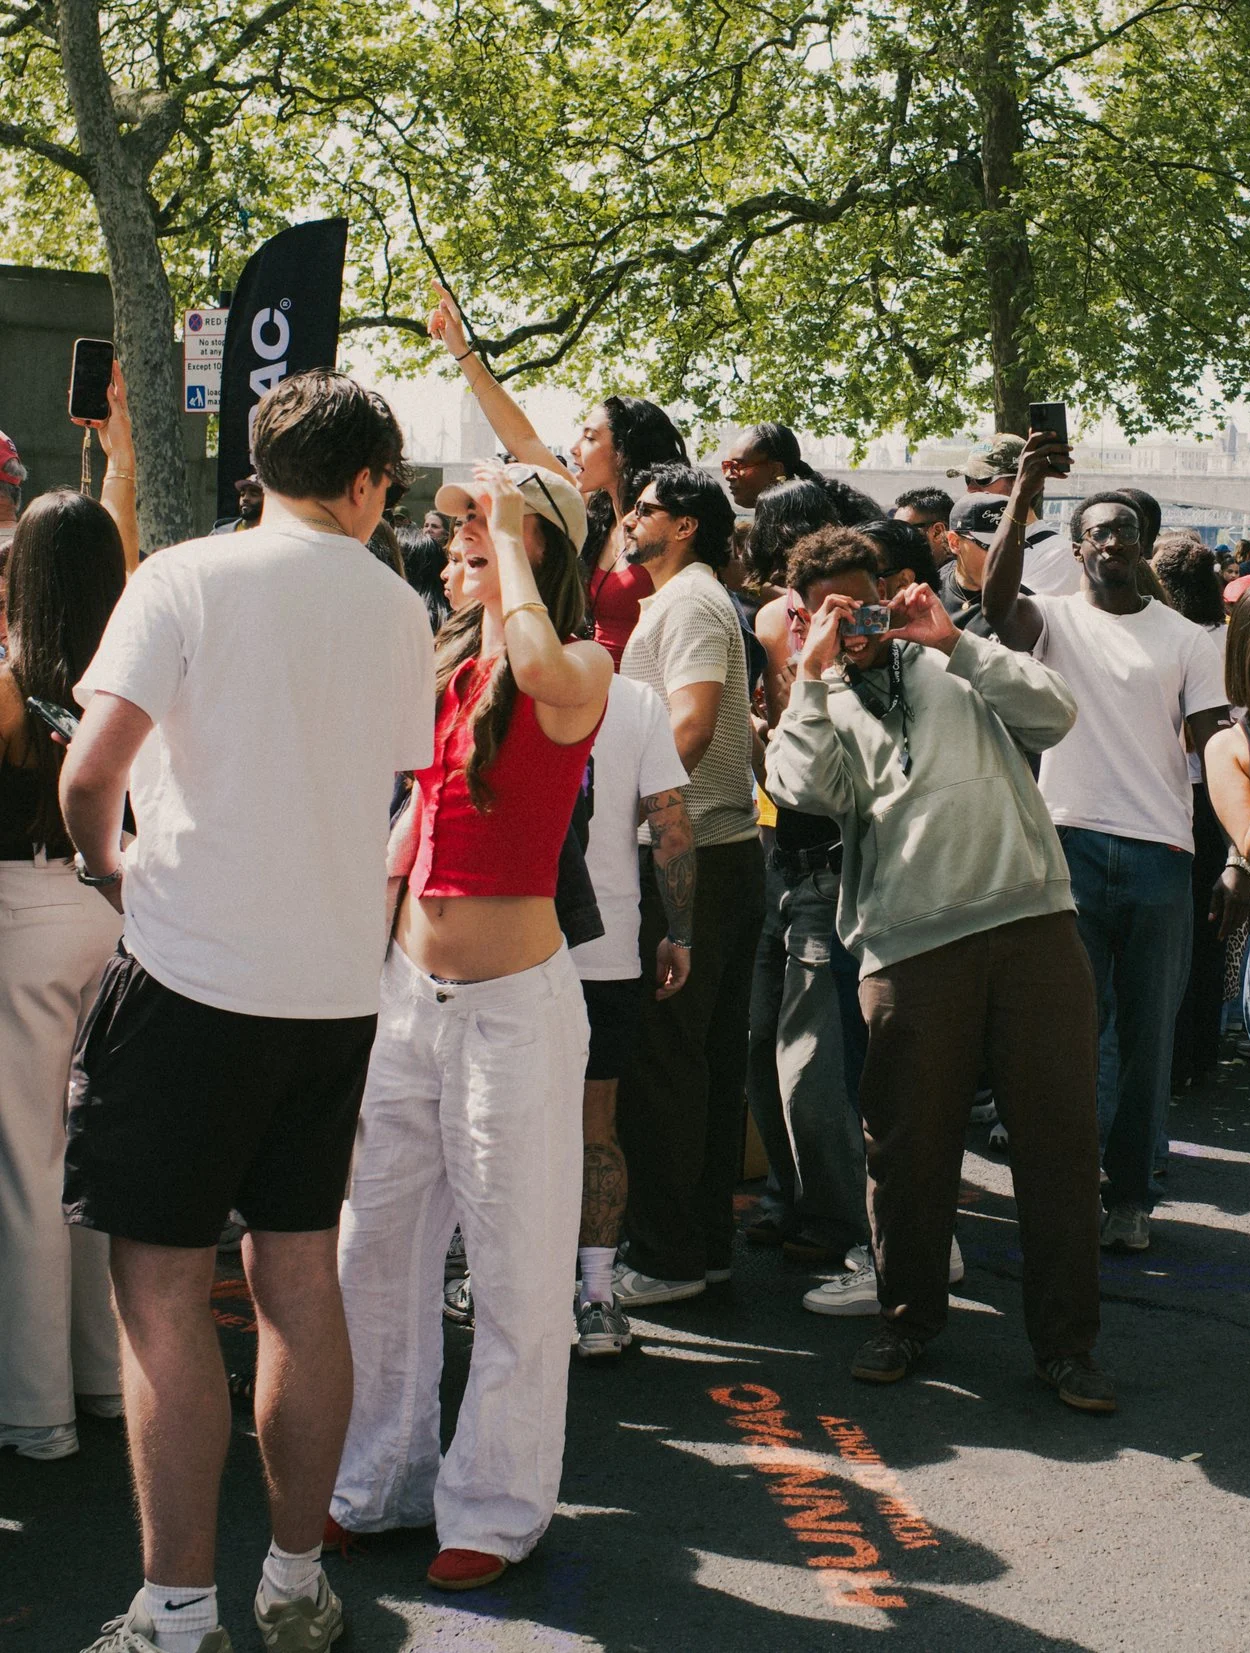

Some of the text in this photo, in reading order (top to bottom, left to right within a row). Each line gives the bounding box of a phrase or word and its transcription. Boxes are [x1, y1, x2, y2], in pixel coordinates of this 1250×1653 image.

[205, 317, 222, 326] RED
[209, 349, 222, 357] any
[187, 363, 211, 371] Except
